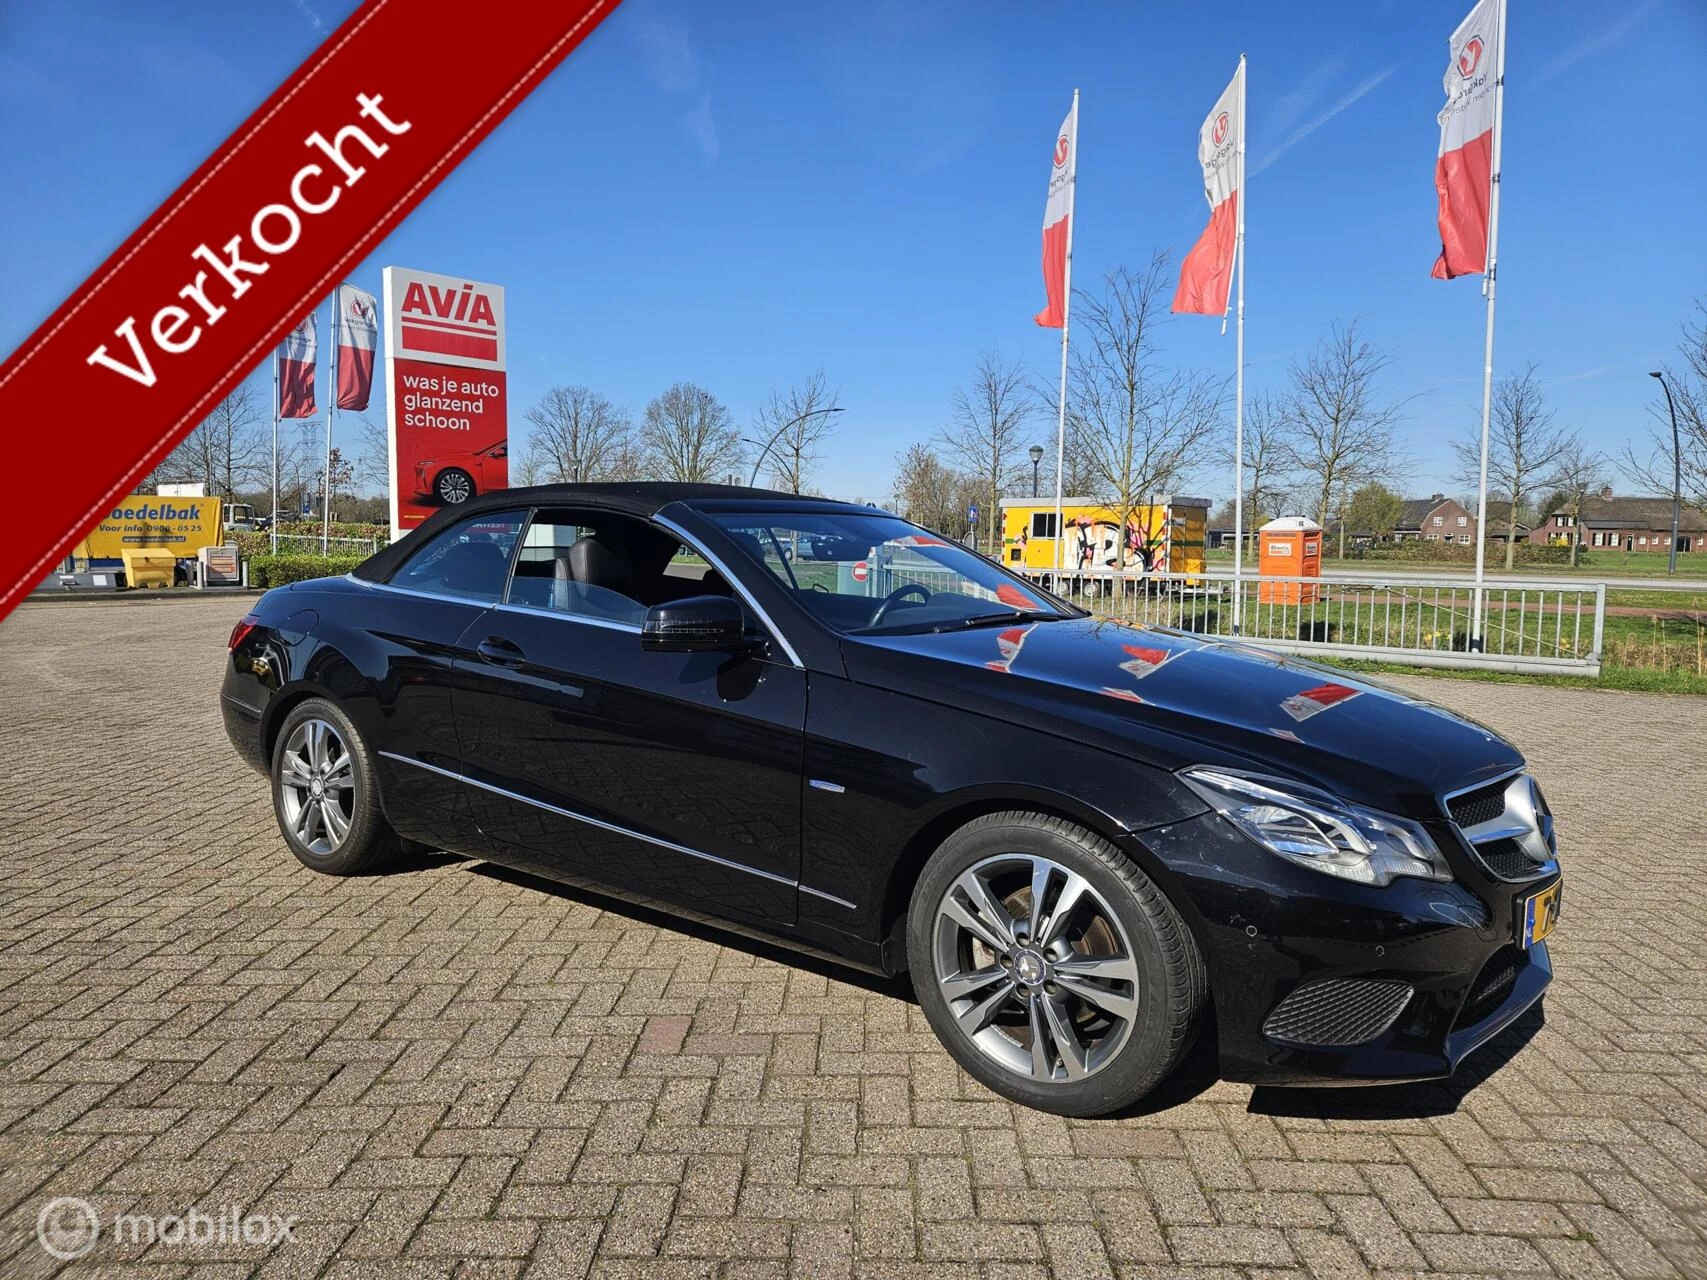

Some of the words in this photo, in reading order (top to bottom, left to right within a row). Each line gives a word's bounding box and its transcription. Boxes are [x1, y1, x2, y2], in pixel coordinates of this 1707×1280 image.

[403, 375, 439, 390] was
[442, 376, 458, 394] je
[461, 382, 499, 397] auto
[404, 393, 483, 414] glanzend
[404, 413, 470, 431] schoon
[105, 504, 200, 520] oedelbak
